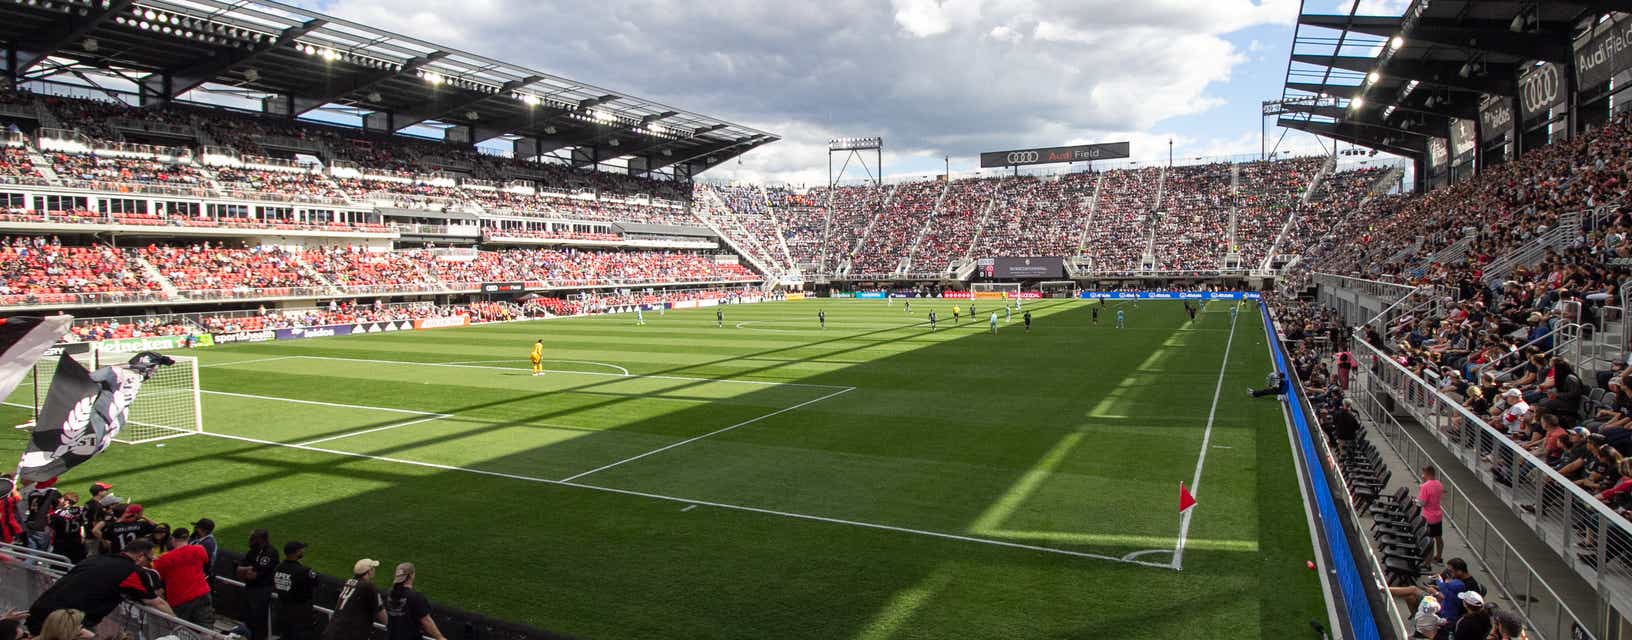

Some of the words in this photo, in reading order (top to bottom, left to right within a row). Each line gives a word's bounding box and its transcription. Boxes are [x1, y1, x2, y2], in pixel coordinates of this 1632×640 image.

[1580, 43, 1607, 73] Audi
[1048, 151, 1072, 161] Audi
[1074, 149, 1100, 159] Field
[303, 328, 335, 338] leidos
[95, 338, 173, 353] Heineken
